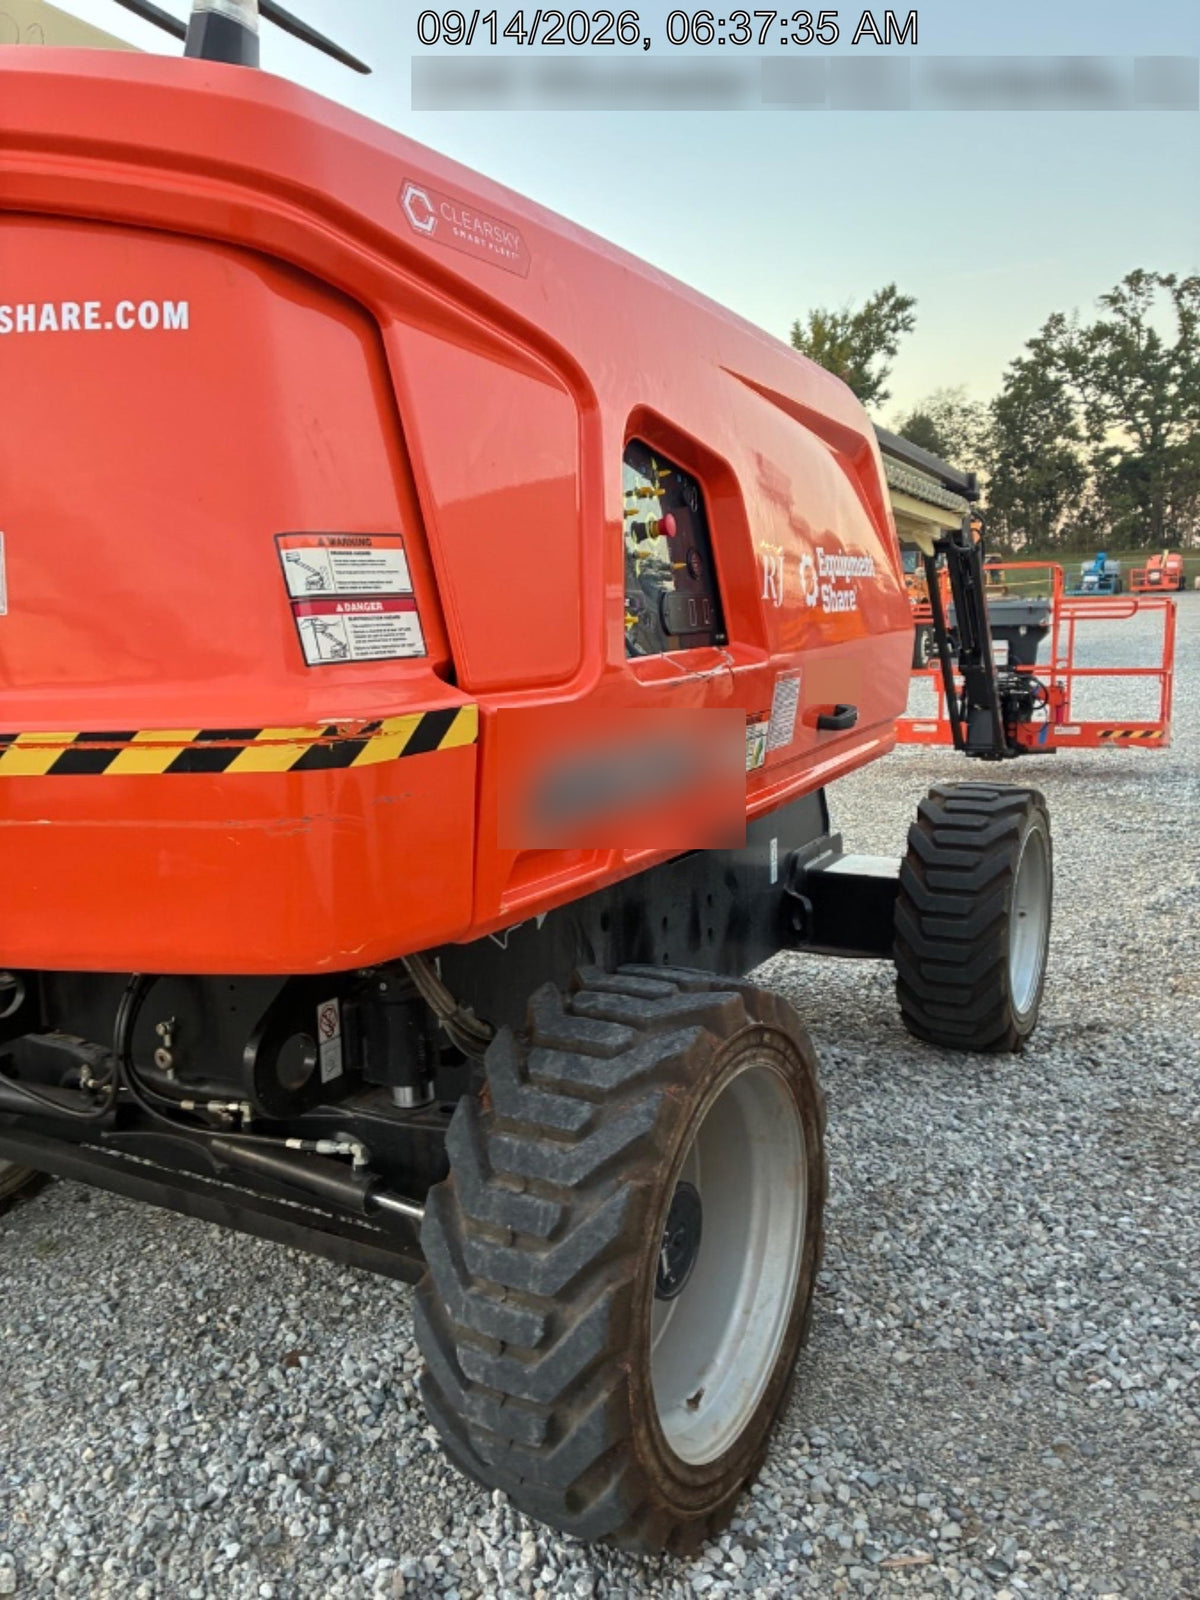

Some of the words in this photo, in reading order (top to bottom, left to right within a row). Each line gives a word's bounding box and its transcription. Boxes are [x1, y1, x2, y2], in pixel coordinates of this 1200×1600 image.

[440, 202, 519, 248] CLEARSKY
[0, 300, 188, 333] SHARE.COM
[328, 536, 372, 547] WARNING
[816, 547, 874, 583] Equipment
[344, 602, 383, 612] DANGER
[821, 585, 856, 613] Share
